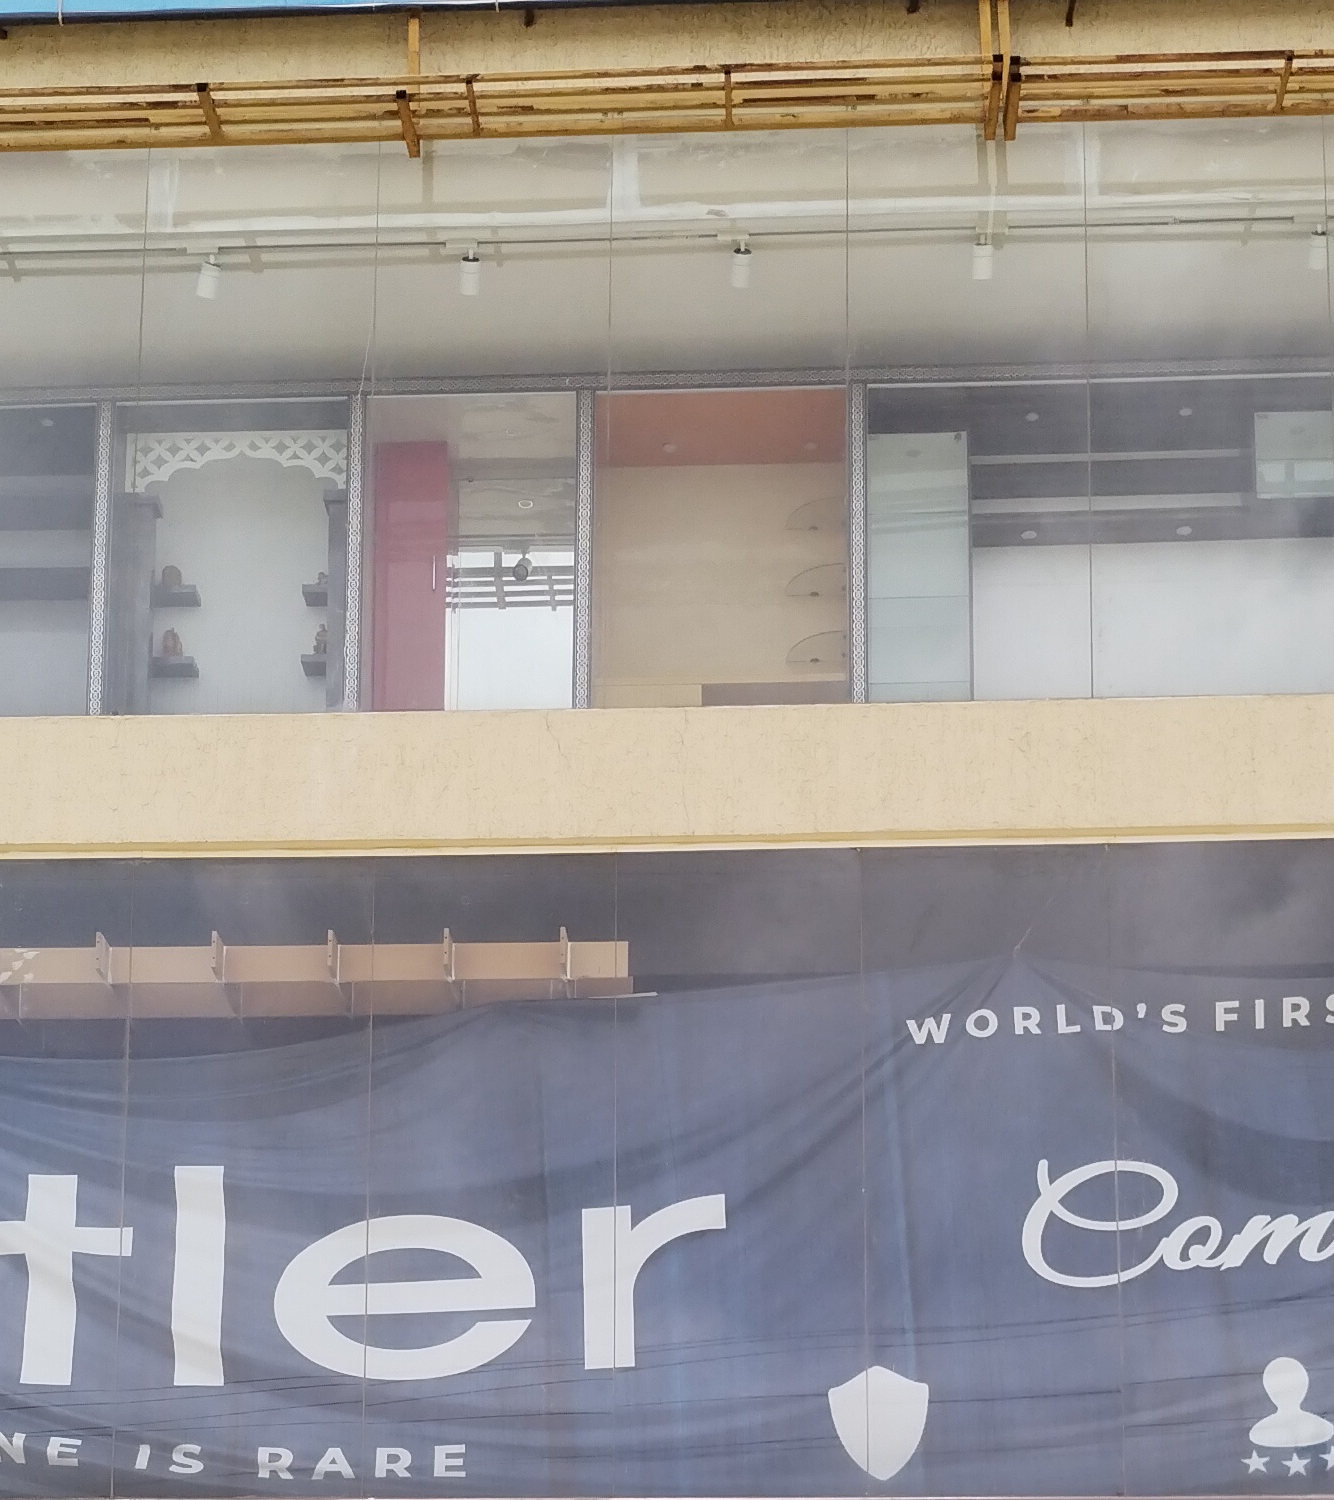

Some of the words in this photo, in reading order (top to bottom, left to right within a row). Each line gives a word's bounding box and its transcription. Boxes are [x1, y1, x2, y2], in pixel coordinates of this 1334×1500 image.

[906, 1002, 1188, 1046] WORLD'S
[135, 1442, 206, 1476] IS
[256, 1443, 467, 1481] RARE
